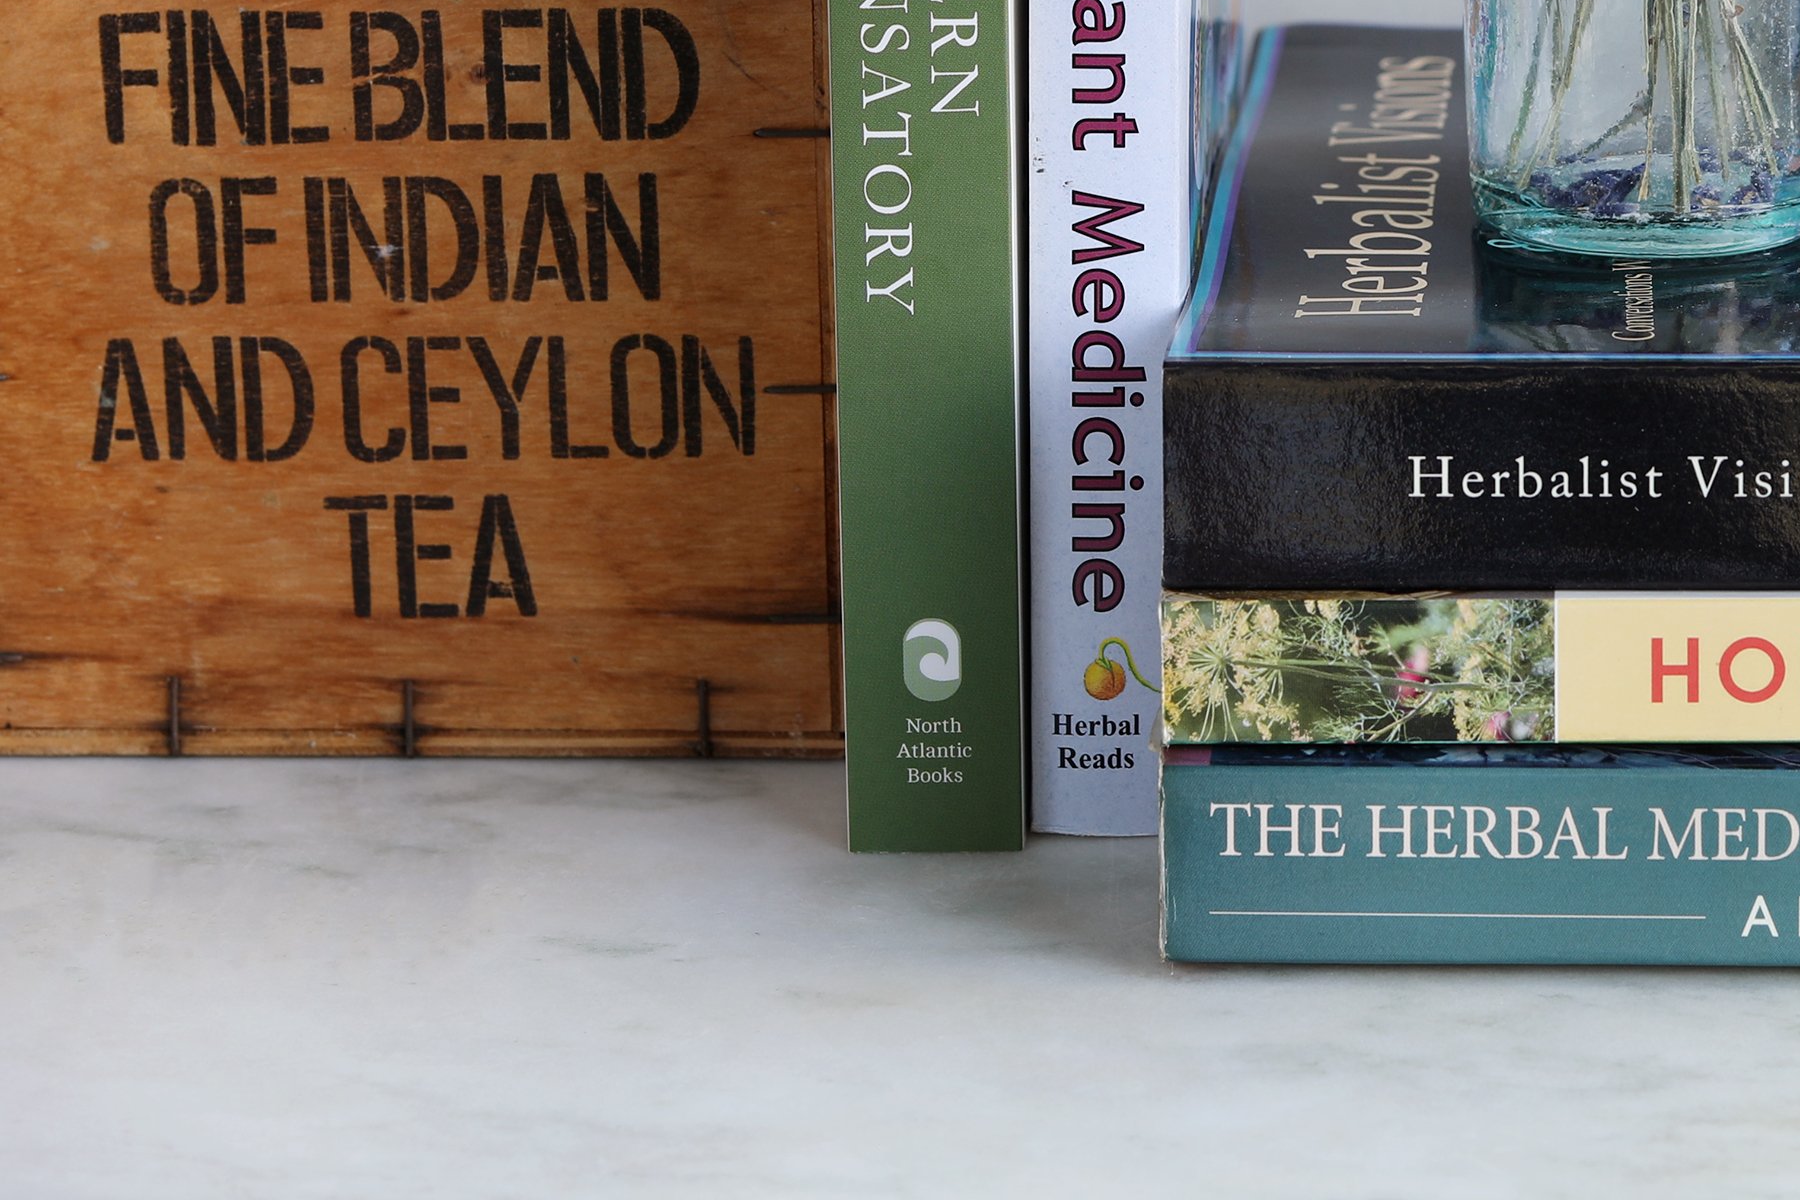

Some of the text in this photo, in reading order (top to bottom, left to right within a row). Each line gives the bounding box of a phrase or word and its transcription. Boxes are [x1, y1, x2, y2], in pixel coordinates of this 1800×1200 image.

[98, 6, 701, 146] FINE BLEND
[1295, 55, 1456, 318] Herbalist Visions
[147, 172, 662, 306] OF INDIAN
[1612, 273, 1655, 341] Conversations
[91, 332, 757, 464] AND CEYLON
[1070, 189, 1147, 613] Medicine
[1408, 456, 1663, 499] Herbalist
[323, 493, 538, 619] TEA
[897, 743, 972, 759] Atlantic
[906, 717, 962, 734] North
[1052, 713, 1141, 736] Herbal
[907, 767, 963, 784] Books
[1058, 746, 1135, 769] Reads
[1210, 802, 1347, 858] THE
[1366, 805, 1629, 861] HERBAL
[1741, 895, 1779, 939] A
